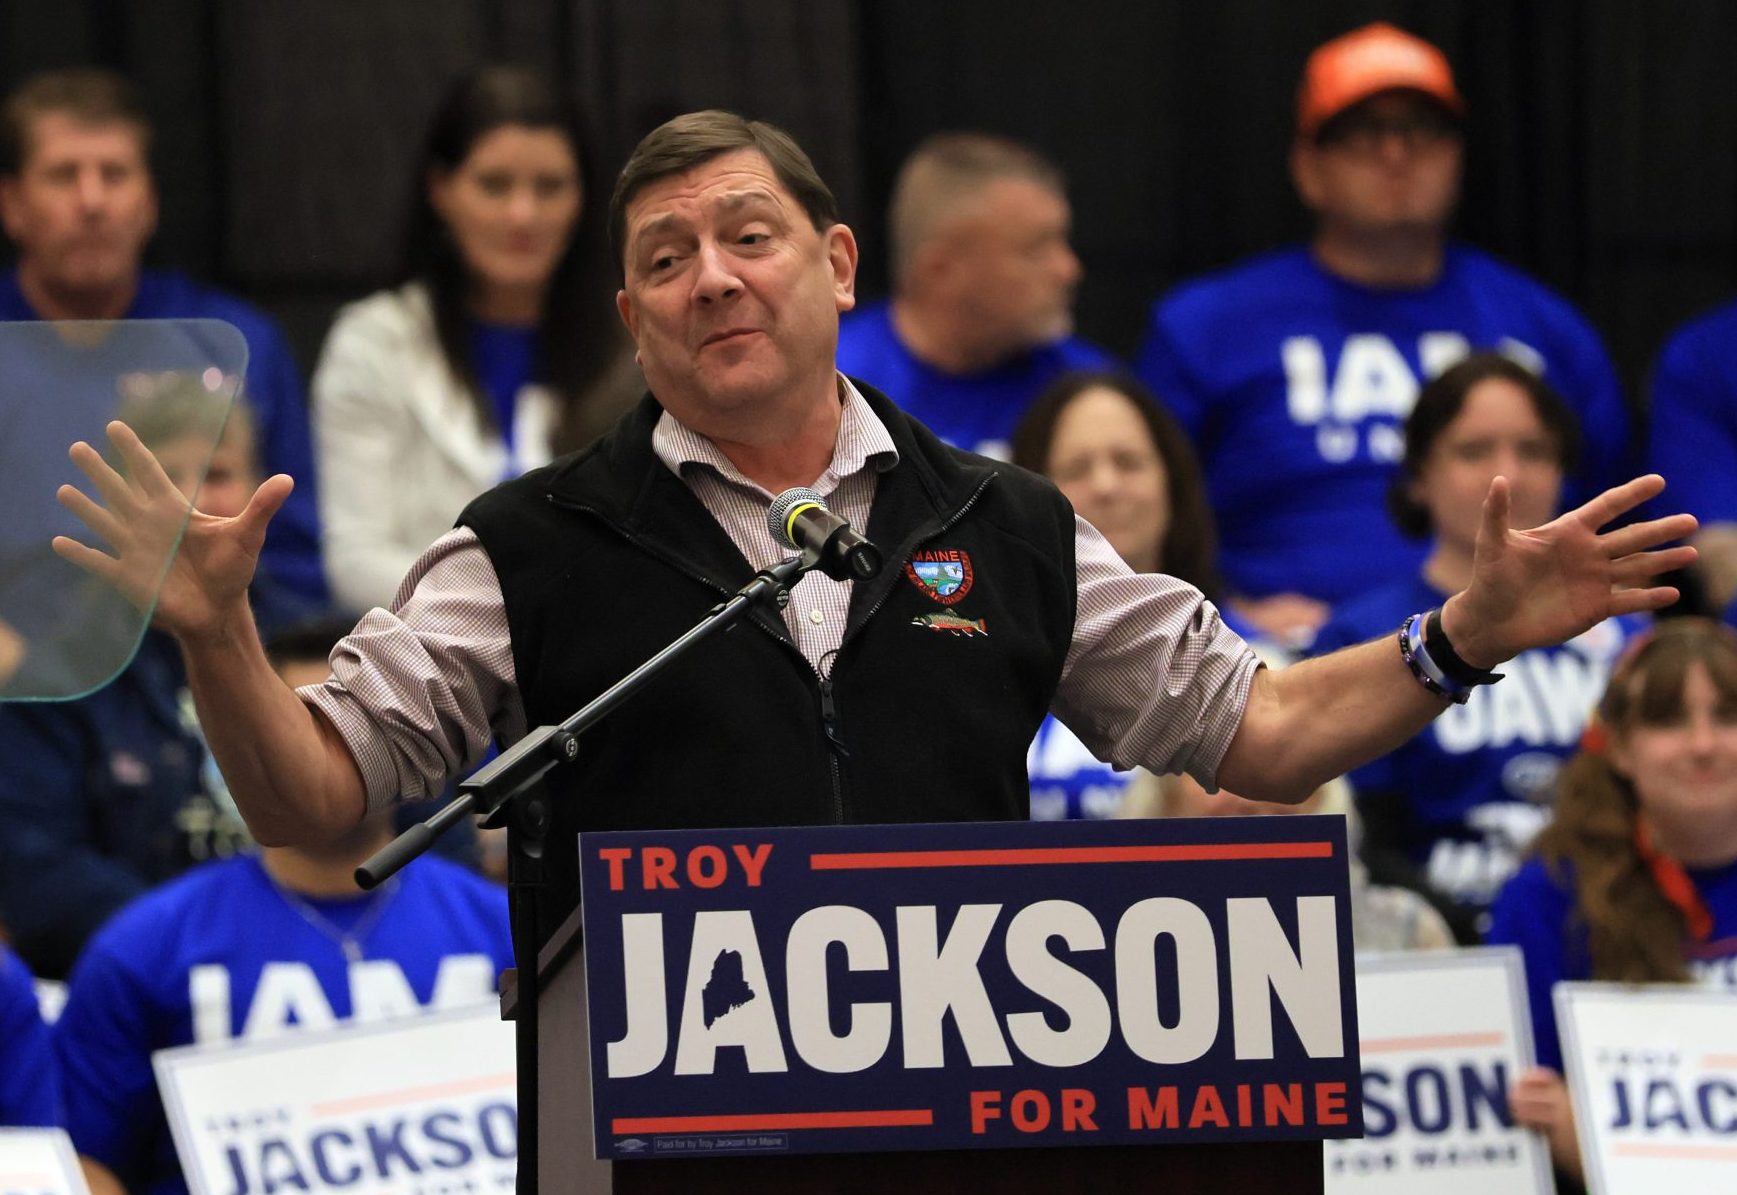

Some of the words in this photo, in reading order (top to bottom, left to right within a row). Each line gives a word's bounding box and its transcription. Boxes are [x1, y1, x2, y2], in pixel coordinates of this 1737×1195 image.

[913, 550, 960, 562] MAINE
[600, 844, 774, 891] TROY
[607, 895, 1345, 1079] JACKSON
[970, 1088, 1100, 1134] FOR
[1127, 1082, 1349, 1131] MAINE
[1610, 1078, 1737, 1134] JAC
[657, 1139, 674, 1149] Paid
[699, 1138, 714, 1150] Troy
[759, 1136, 782, 1146] Maine
